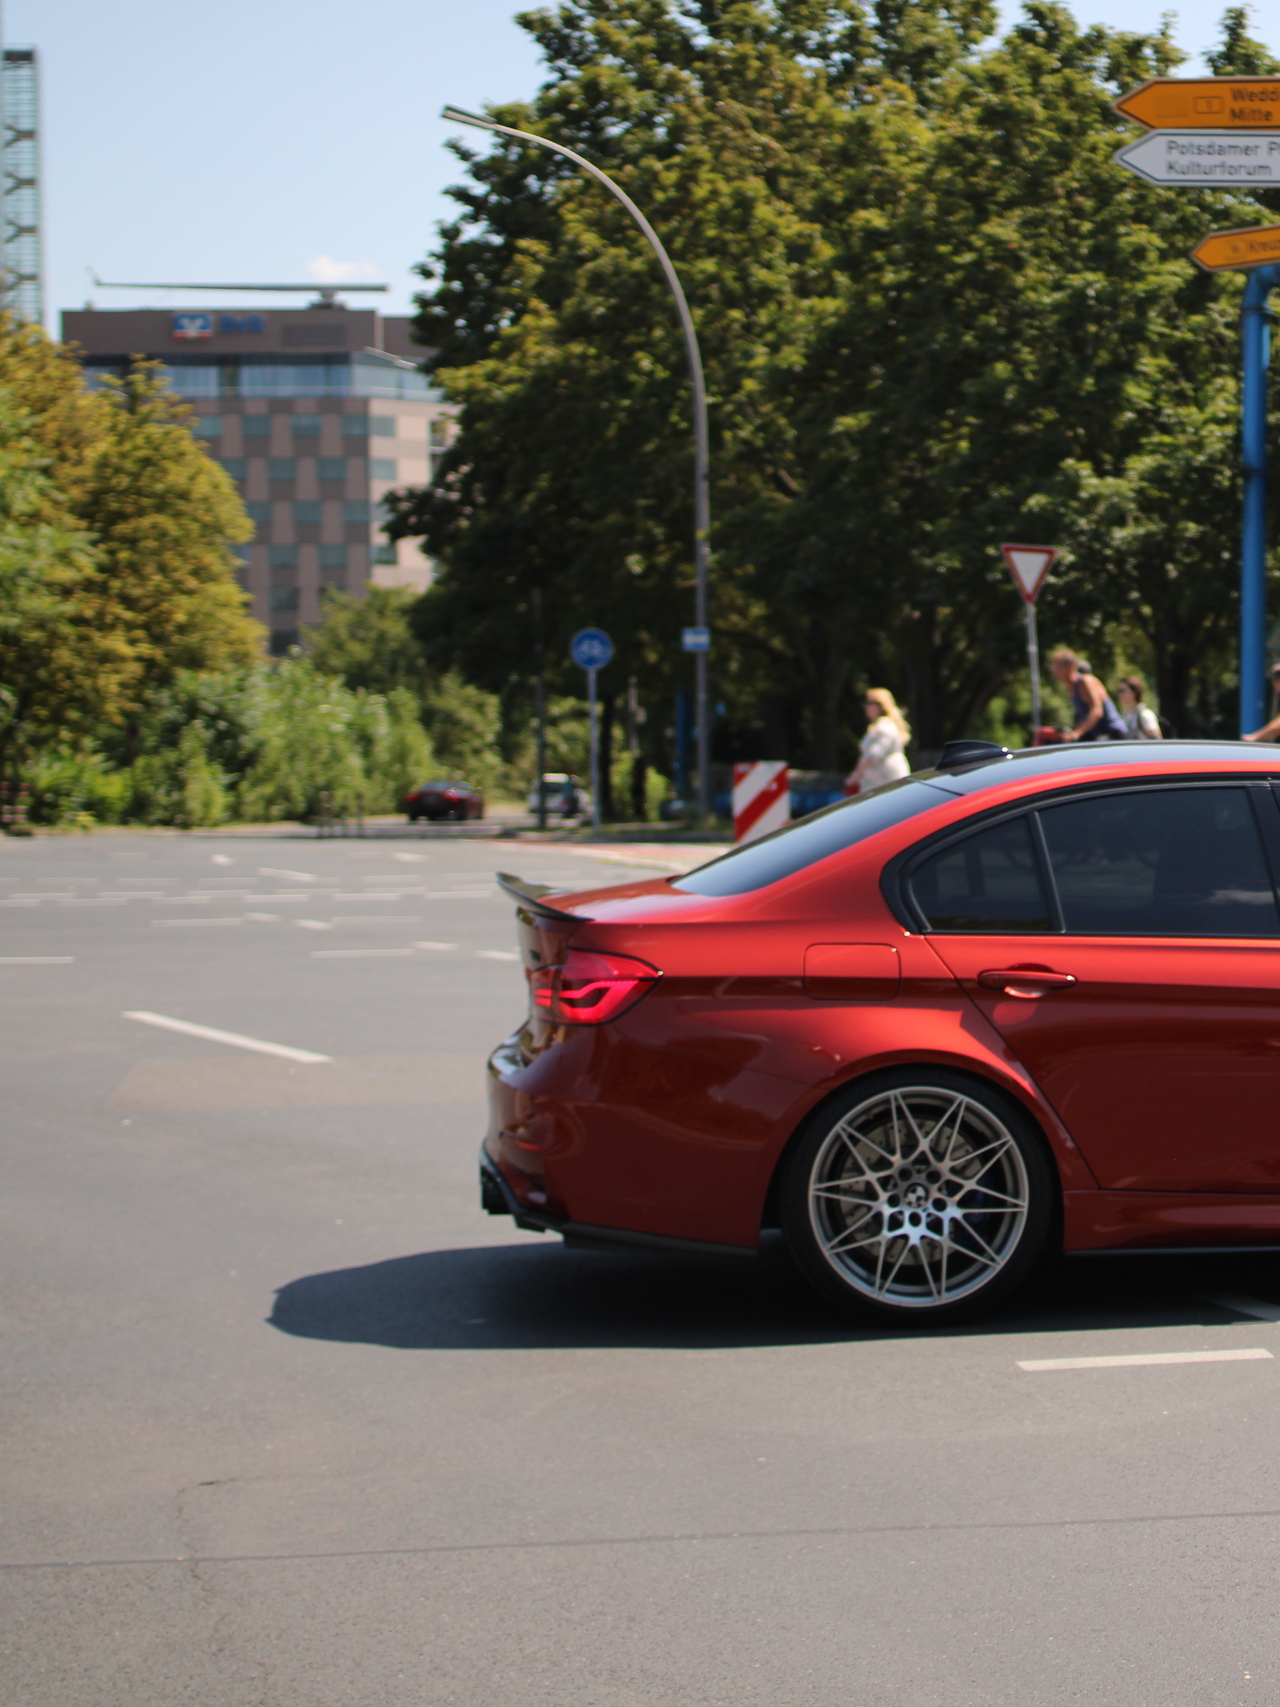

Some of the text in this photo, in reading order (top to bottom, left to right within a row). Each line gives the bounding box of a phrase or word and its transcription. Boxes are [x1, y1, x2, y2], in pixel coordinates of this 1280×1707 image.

[1231, 108, 1273, 121] Mitte
[1167, 141, 1261, 156] Potsdamer
[1167, 161, 1272, 177] Kulturforum
